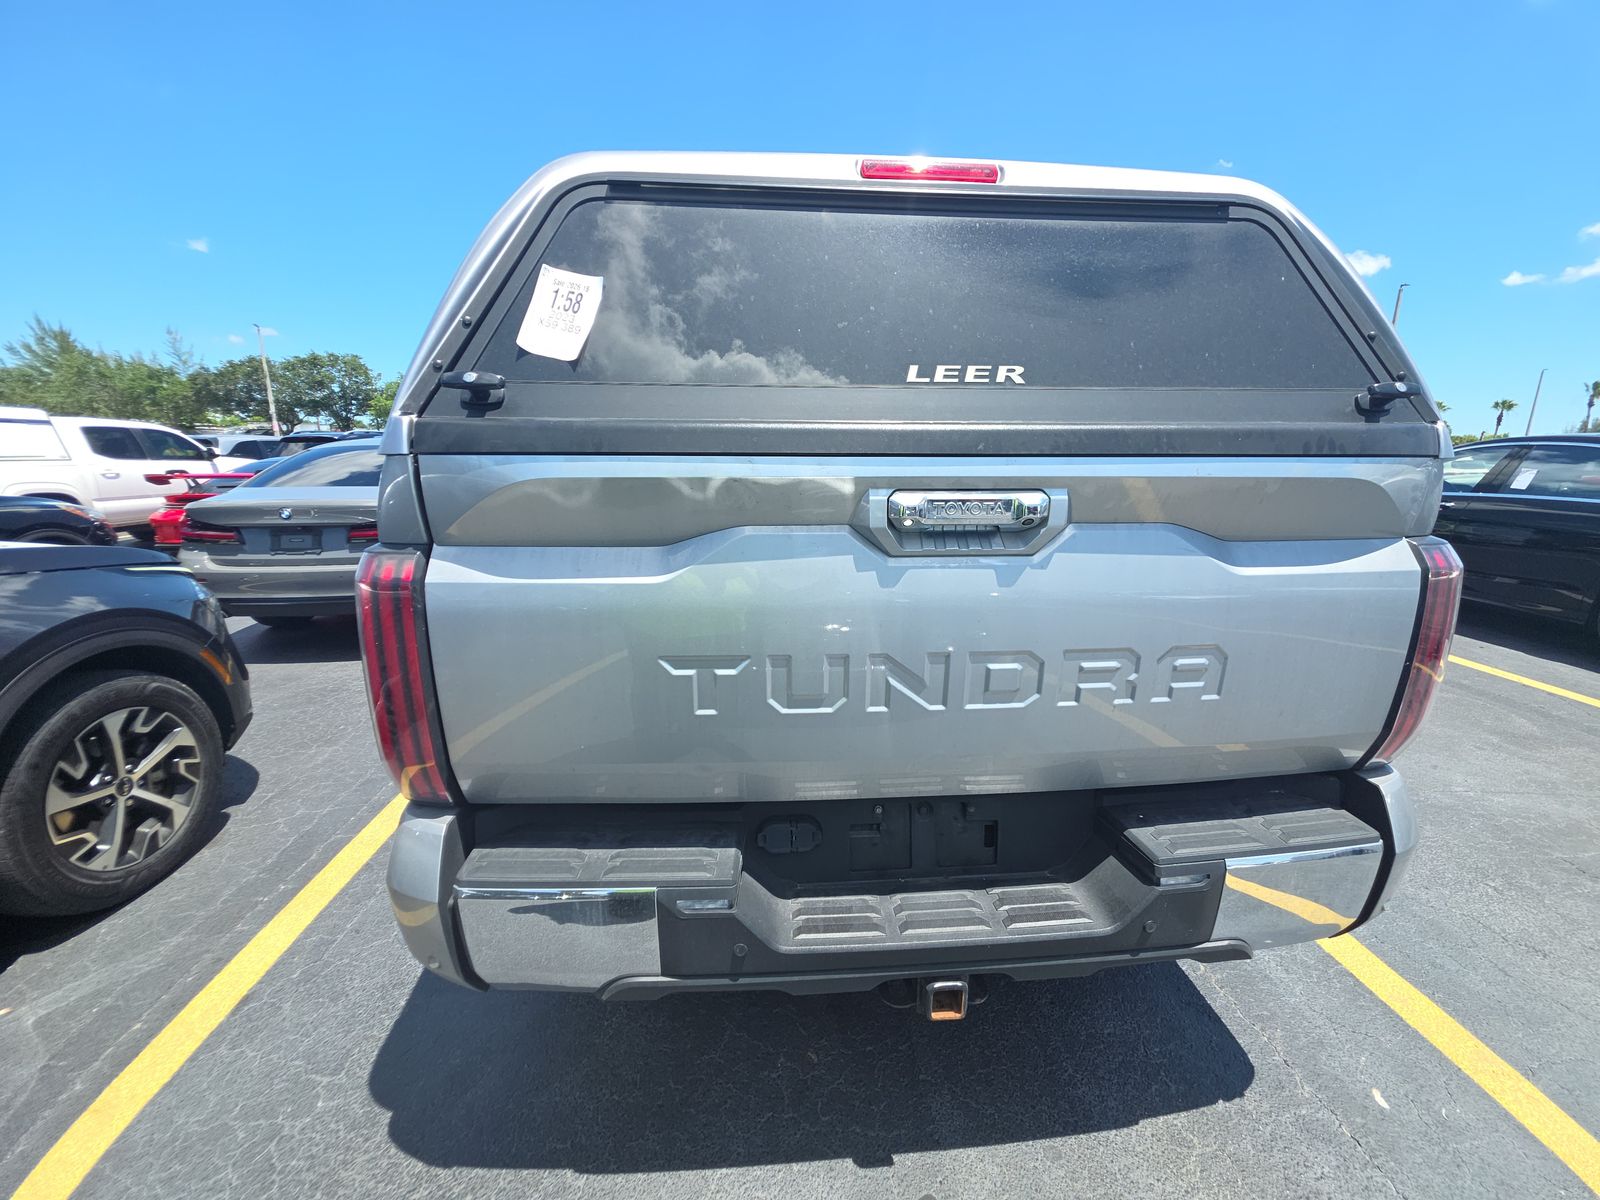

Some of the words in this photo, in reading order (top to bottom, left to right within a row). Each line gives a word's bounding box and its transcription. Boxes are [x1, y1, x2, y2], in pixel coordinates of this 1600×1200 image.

[551, 287, 583, 314] 1:58
[906, 365, 1026, 384] LEER
[932, 501, 1007, 516] TOYOTA
[657, 643, 1229, 716] TUNDRA
